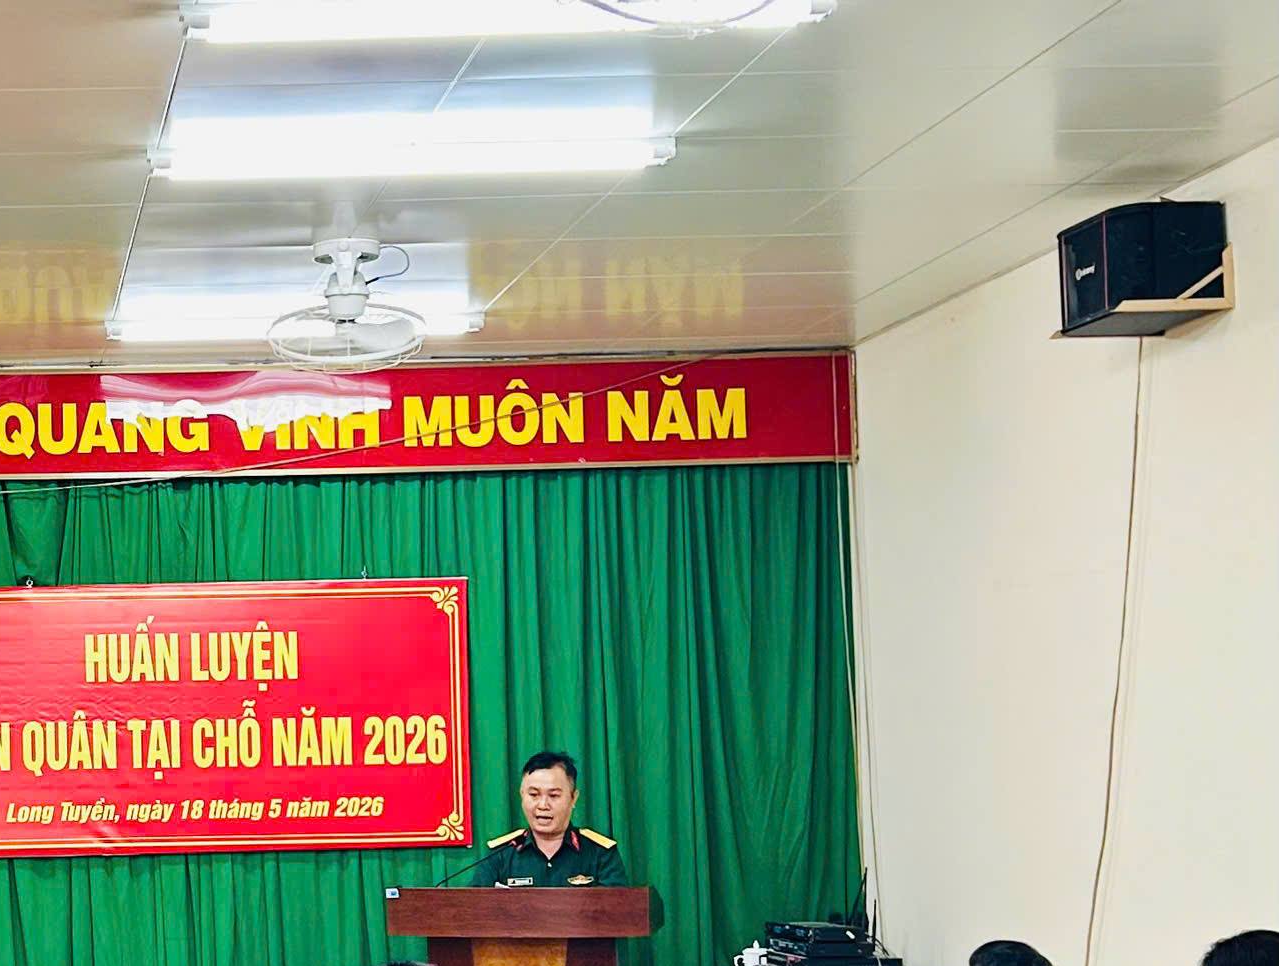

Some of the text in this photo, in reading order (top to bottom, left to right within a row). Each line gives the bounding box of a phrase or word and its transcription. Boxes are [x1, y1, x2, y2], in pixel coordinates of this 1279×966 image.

[404, 379, 584, 447] MUÔN
[607, 374, 747, 442] NĂM
[84, 615, 299, 691] HUẤN LUYỆN
[22, 710, 117, 777] QUÂN
[126, 718, 181, 780] TẠI
[192, 699, 261, 769] CHỖ
[272, 706, 353, 767] NĂM
[363, 714, 447, 765] 2026
[6, 796, 385, 824] Long Tuyền, ngày 18 tháng 5 năm 2026
